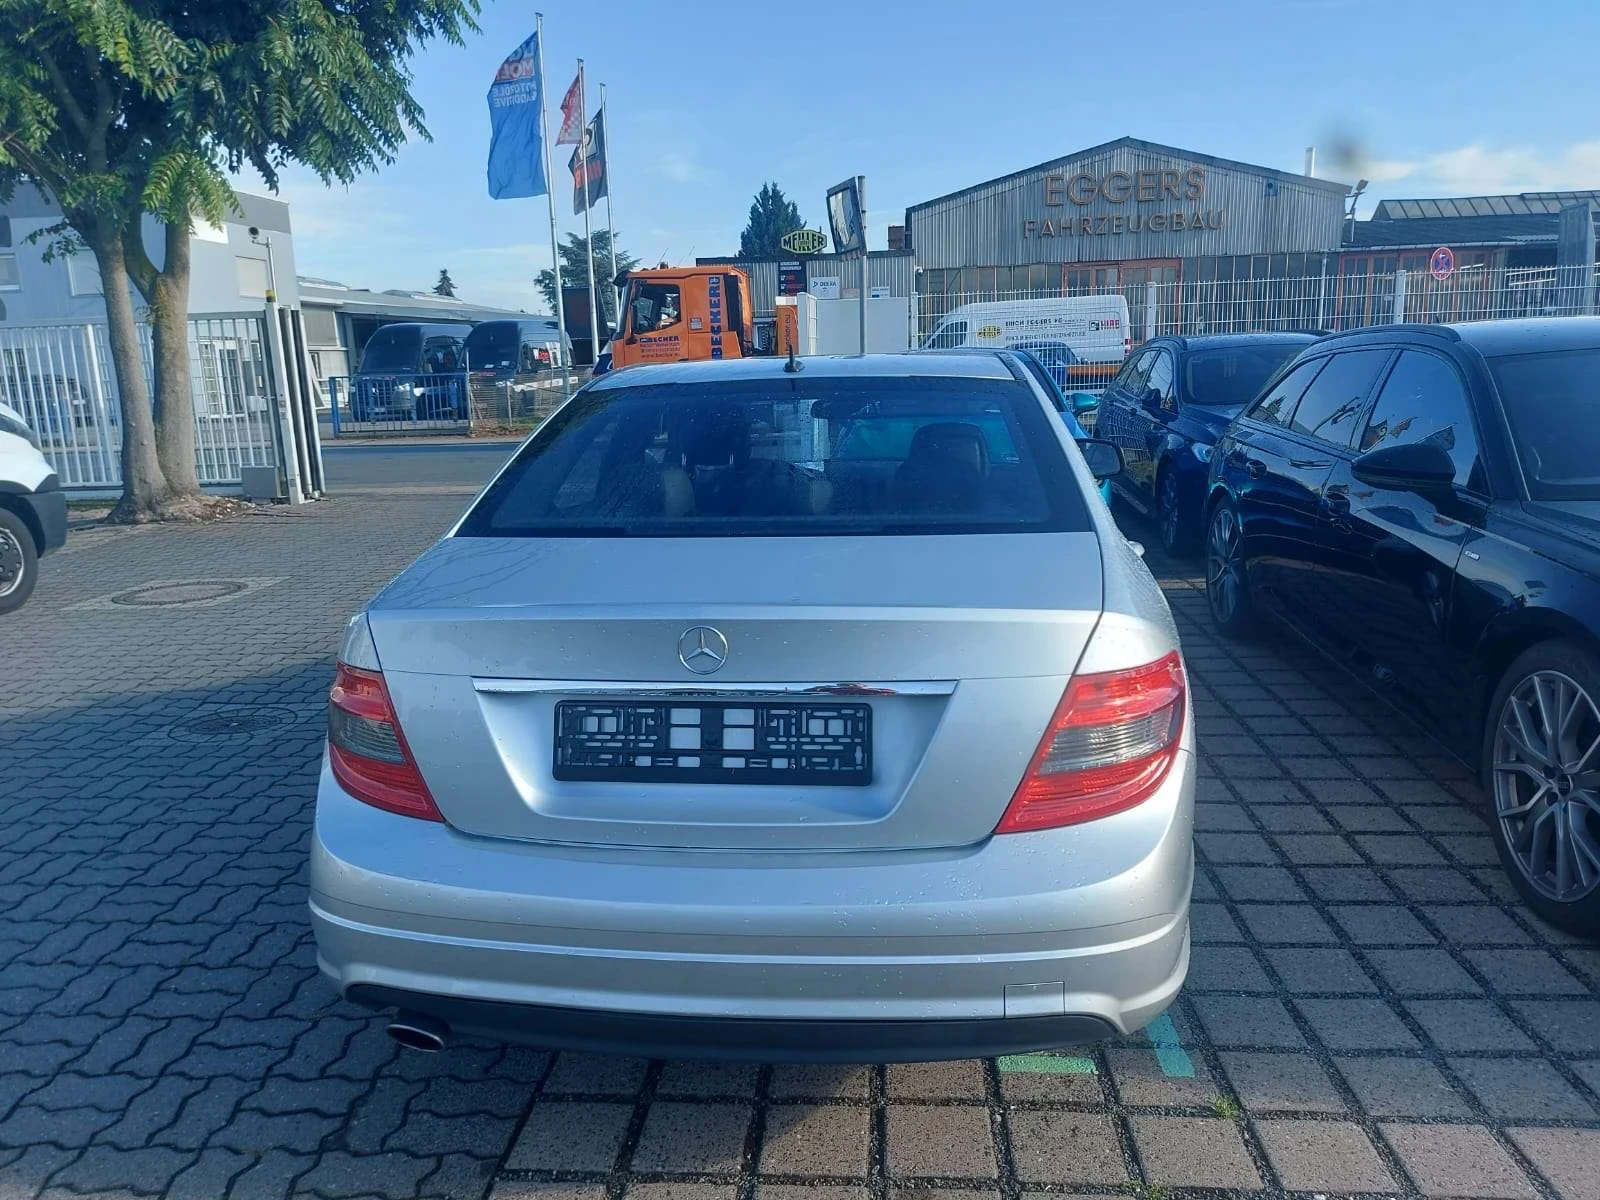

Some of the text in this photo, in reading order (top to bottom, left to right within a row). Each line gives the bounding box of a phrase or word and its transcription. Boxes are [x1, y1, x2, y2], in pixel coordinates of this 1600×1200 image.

[1044, 166, 1207, 206] EGGERS
[1023, 208, 1226, 239] FAHRZEUGBAU
[783, 231, 824, 251] MEILLER
